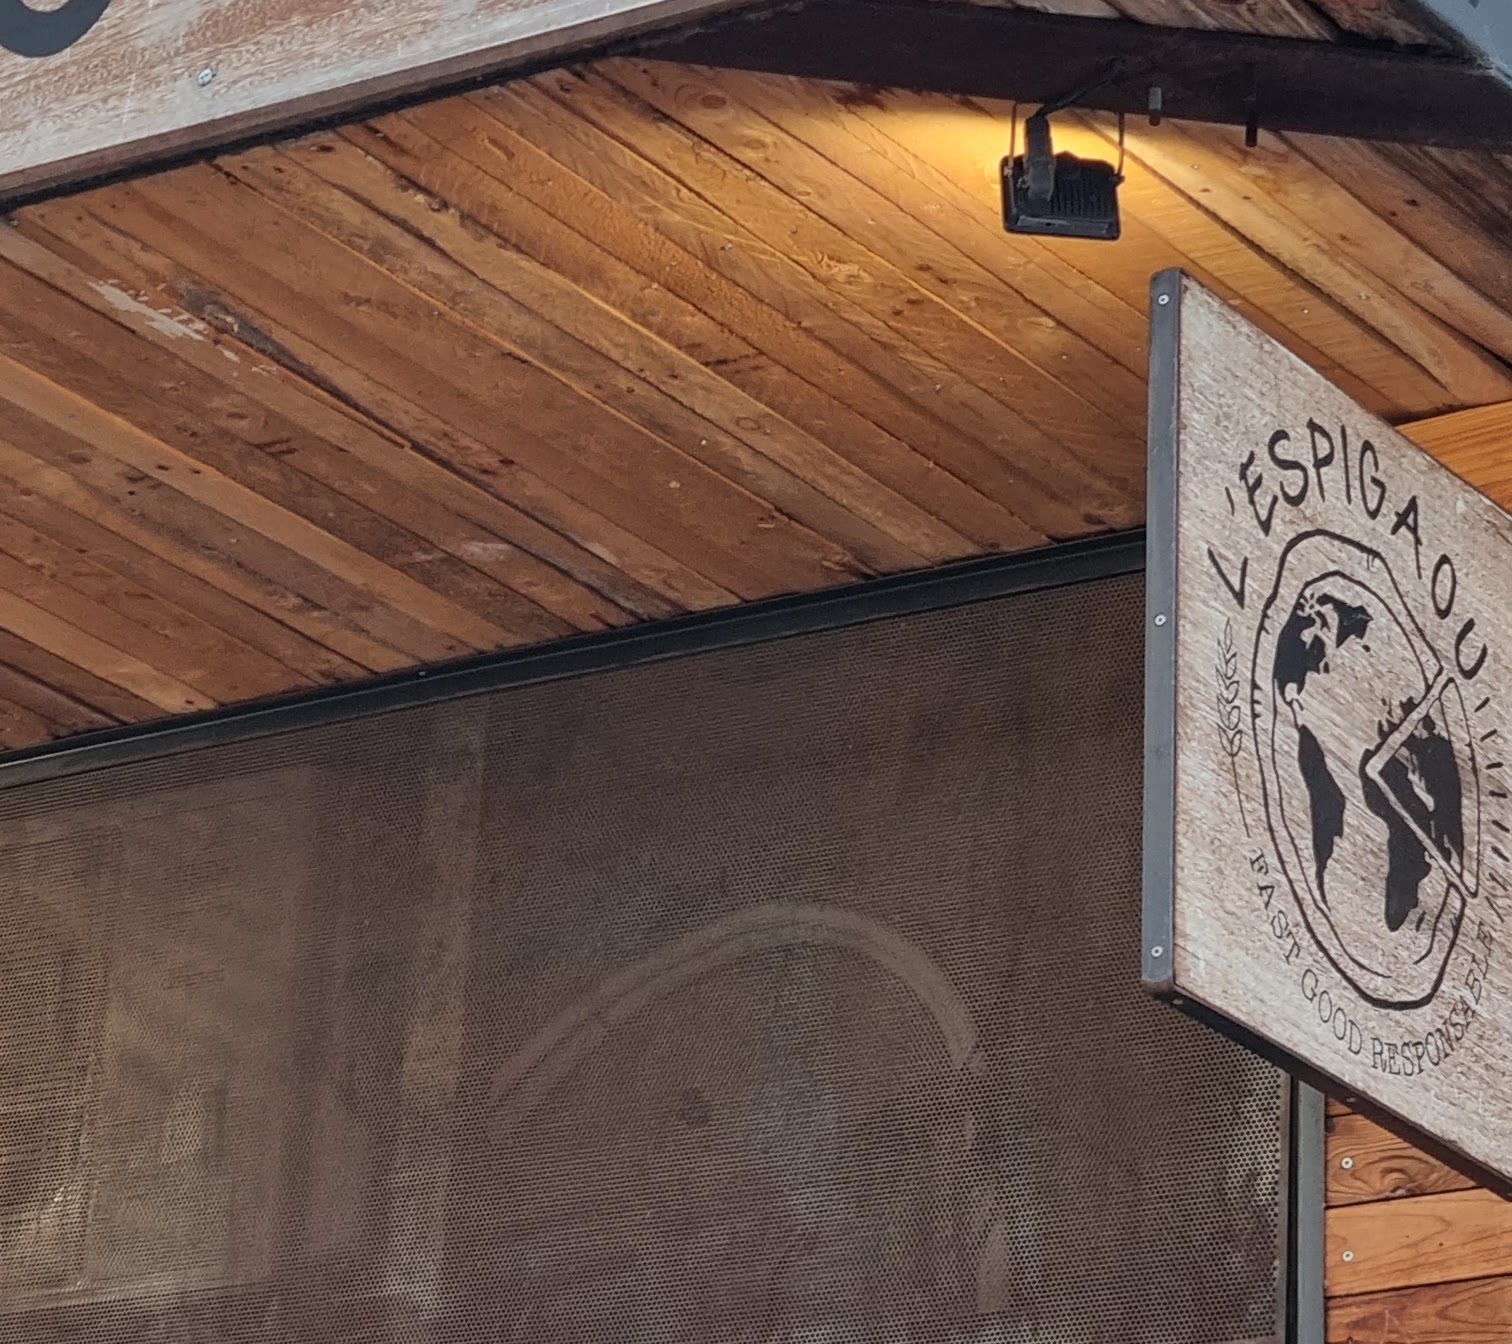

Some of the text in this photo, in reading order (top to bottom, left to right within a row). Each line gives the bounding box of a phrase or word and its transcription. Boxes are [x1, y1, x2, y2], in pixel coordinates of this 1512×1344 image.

[1207, 417, 1488, 680] L'ESPIGAOU
[1249, 848, 1493, 1077] FAST GOOD RESPONSABLE
